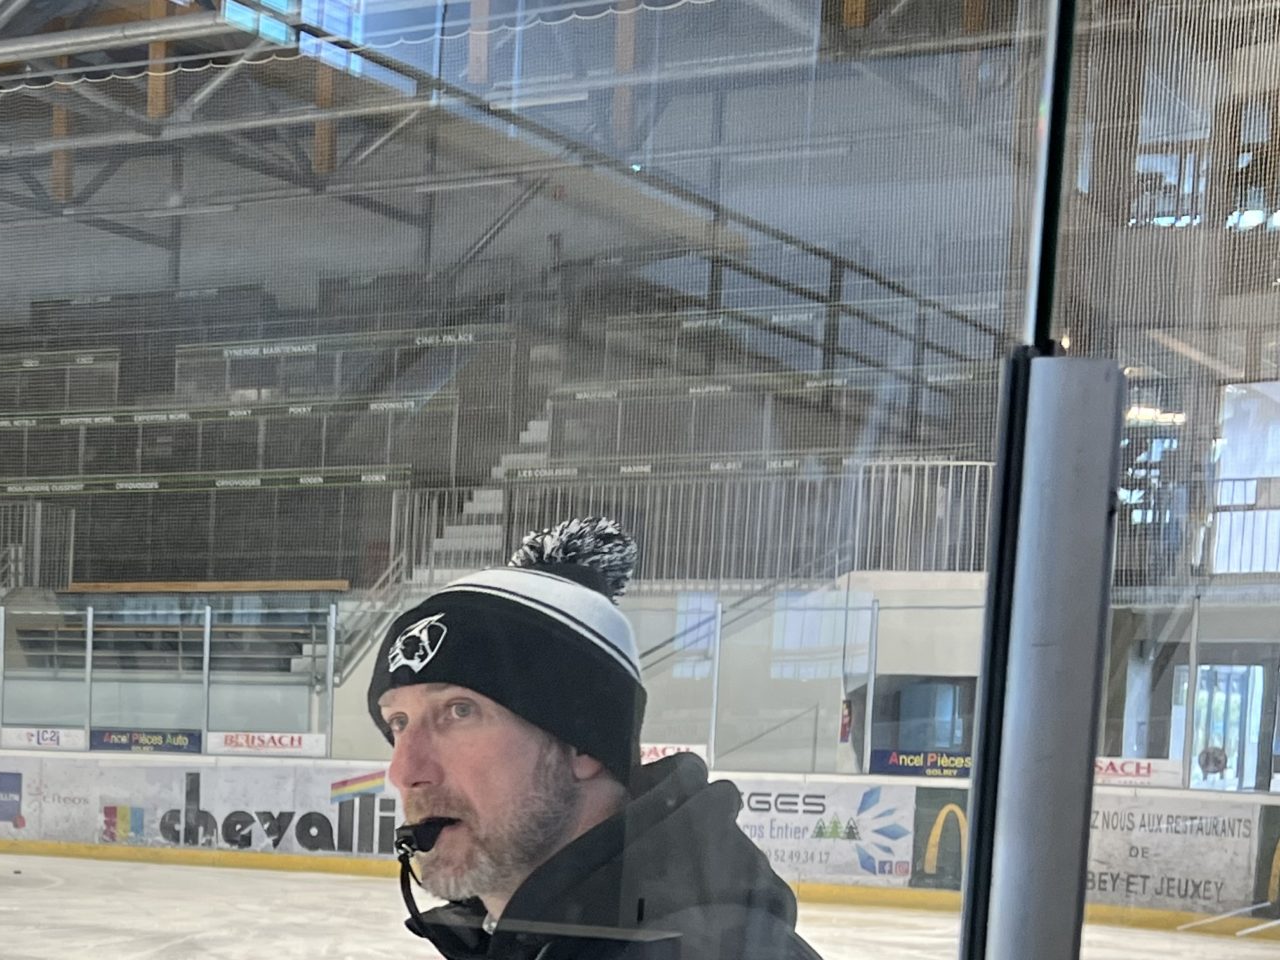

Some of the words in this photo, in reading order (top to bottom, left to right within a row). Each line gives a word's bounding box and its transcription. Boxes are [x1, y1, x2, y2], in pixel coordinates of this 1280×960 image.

[103, 732, 130, 745] Ancel
[165, 735, 189, 747] Auto
[888, 751, 924, 766] Ancel
[926, 752, 972, 768] Pièces
[1094, 761, 1152, 778] SACH
[160, 773, 396, 854] chevalli
[746, 793, 826, 815] GES
[770, 819, 809, 839] Entier
[1102, 811, 1135, 831] NOUS
[1139, 813, 1163, 832] AUX
[1166, 814, 1252, 838] RESTAURANTS
[1125, 874, 1151, 895] ET
[1154, 877, 1224, 900] JEUXEY
